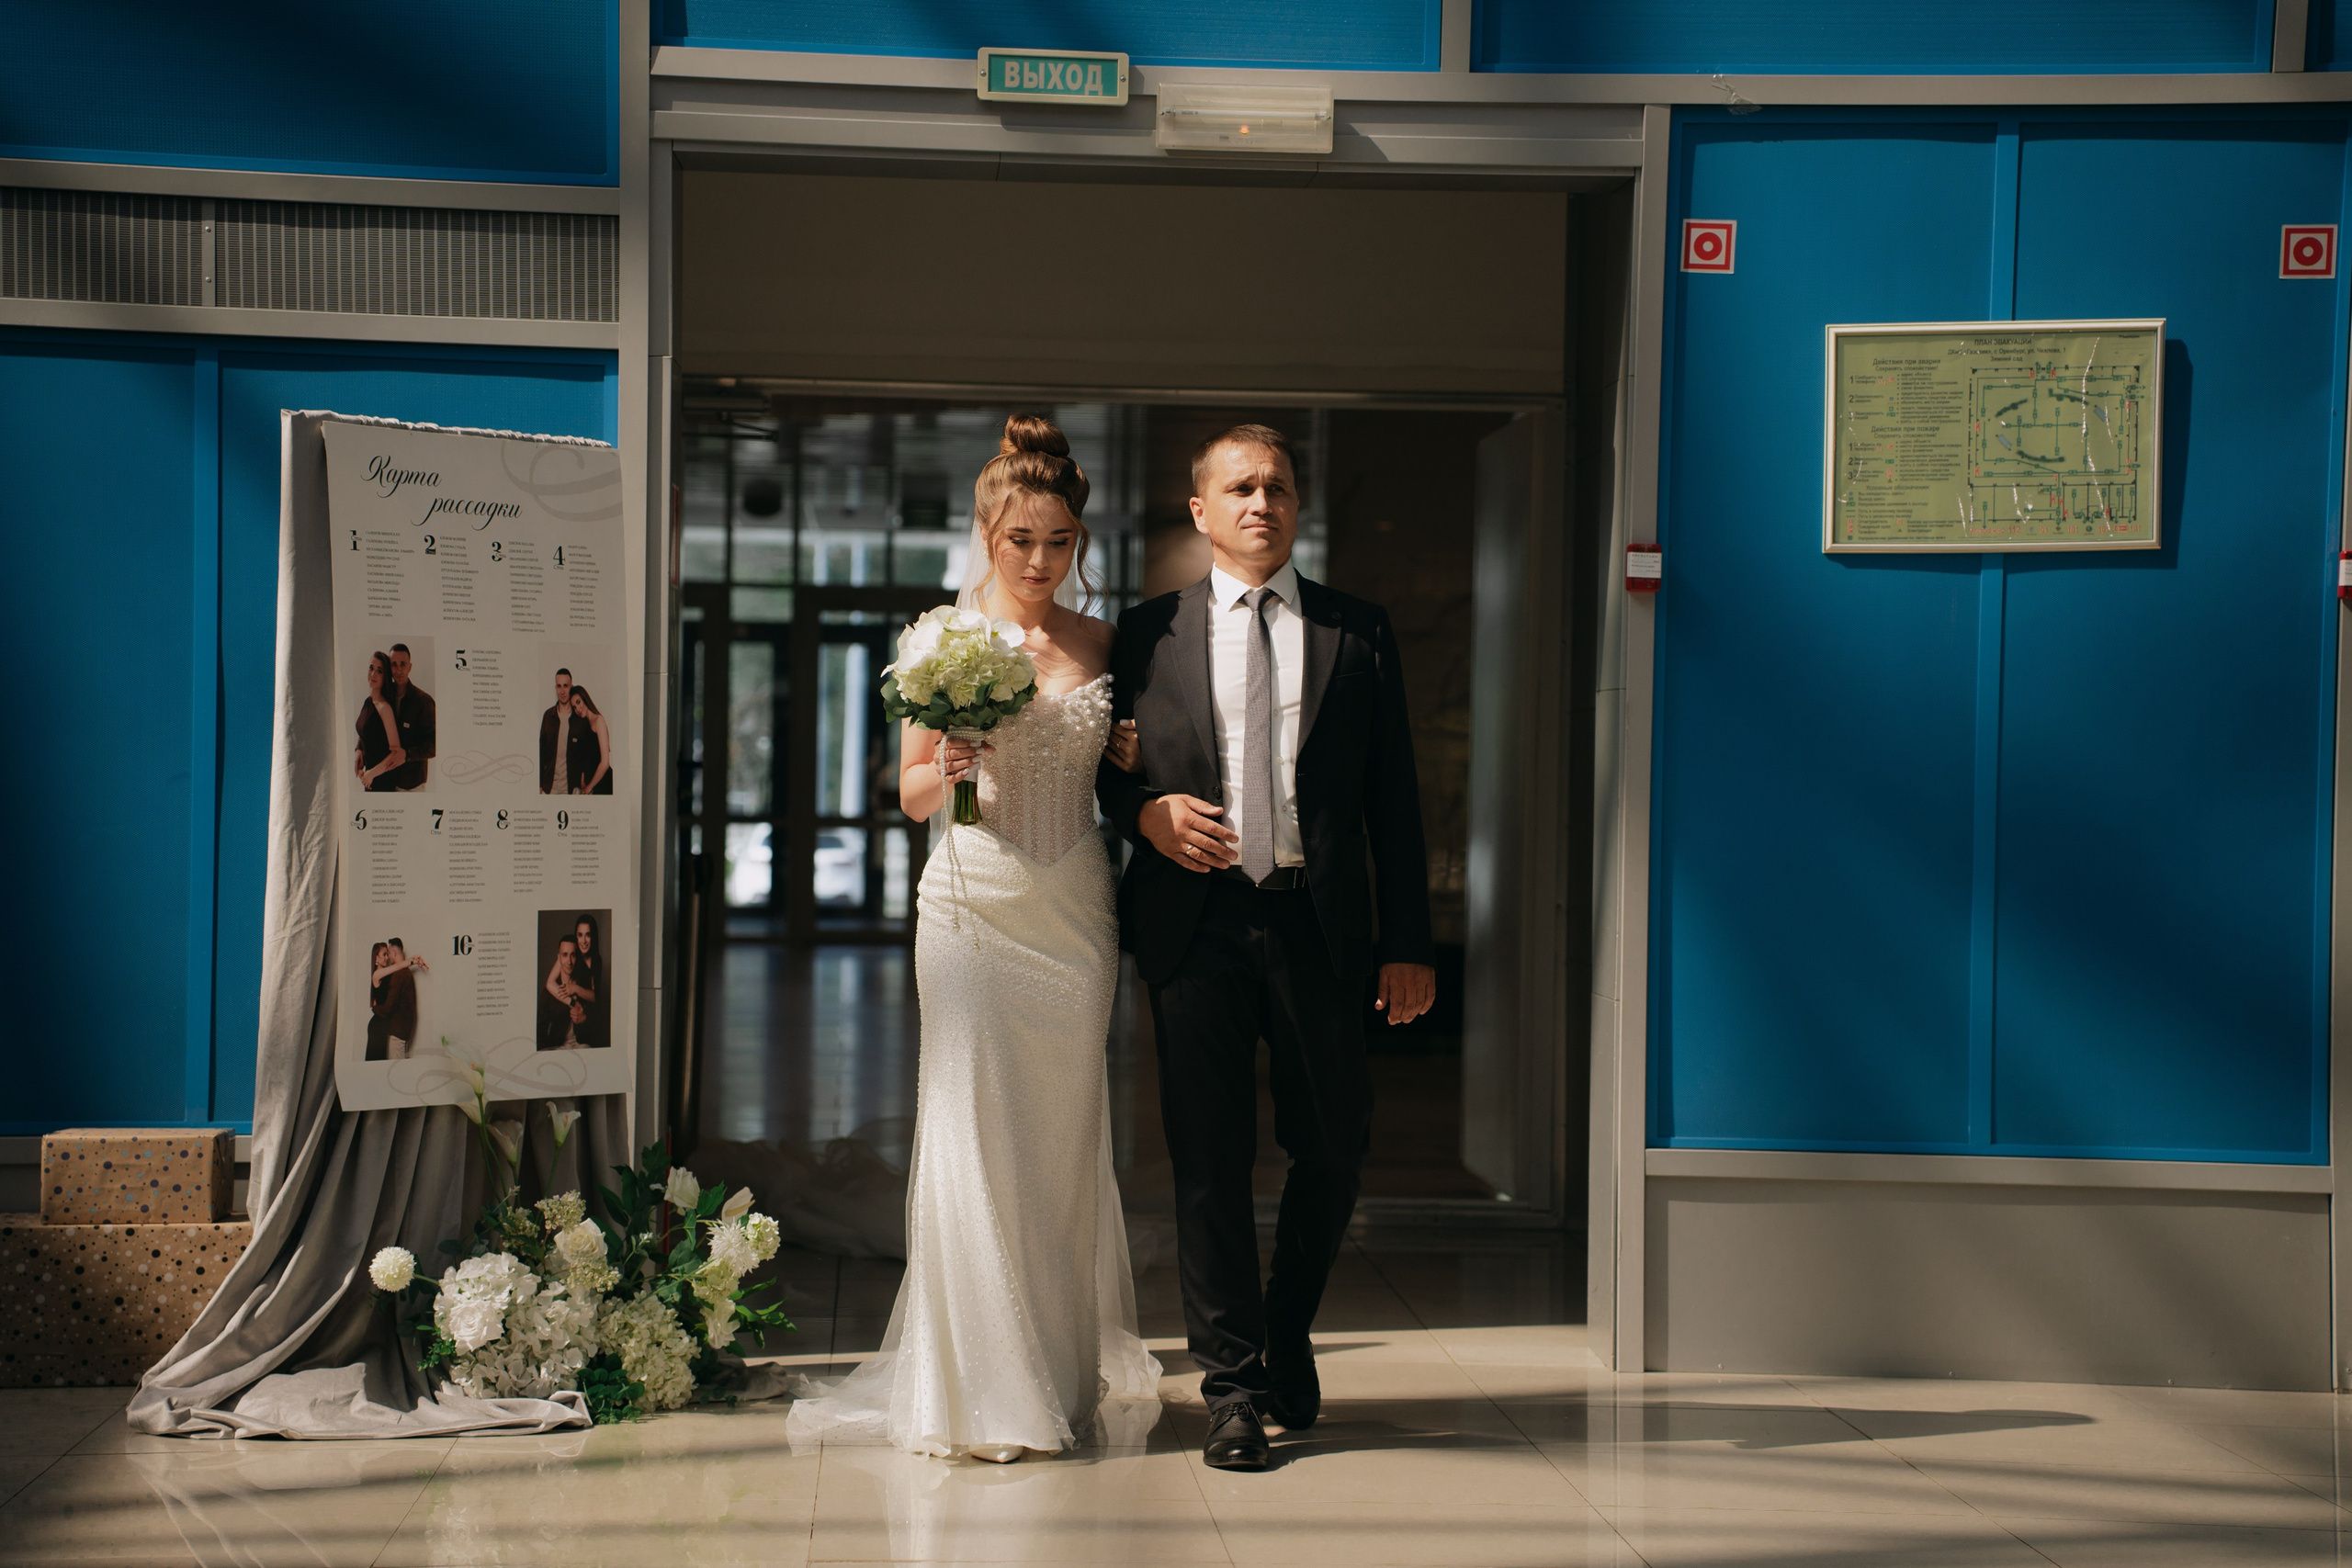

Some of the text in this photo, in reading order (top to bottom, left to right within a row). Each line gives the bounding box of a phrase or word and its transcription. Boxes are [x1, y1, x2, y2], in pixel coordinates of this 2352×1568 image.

[1004, 61, 1102, 96] ВЫХОД
[1872, 358, 1903, 367] Действия
[1849, 376, 1854, 384] 1
[1849, 394, 1854, 403] 2
[1849, 443, 1853, 451] 1
[1848, 457, 1854, 466] 2
[360, 455, 442, 498] Карта
[1848, 471, 1854, 480] 3
[411, 497, 523, 531] рассадки
[2007, 525, 2021, 534] 112
[349, 529, 360, 551] 1
[424, 535, 436, 555] 2
[492, 541, 503, 562] 3
[553, 546, 566, 566] 4
[455, 649, 468, 671] 5
[355, 809, 368, 830] 6
[432, 809, 444, 829] 7
[496, 809, 508, 830] 8
[557, 810, 569, 830] 9
[451, 934, 473, 956] 10
